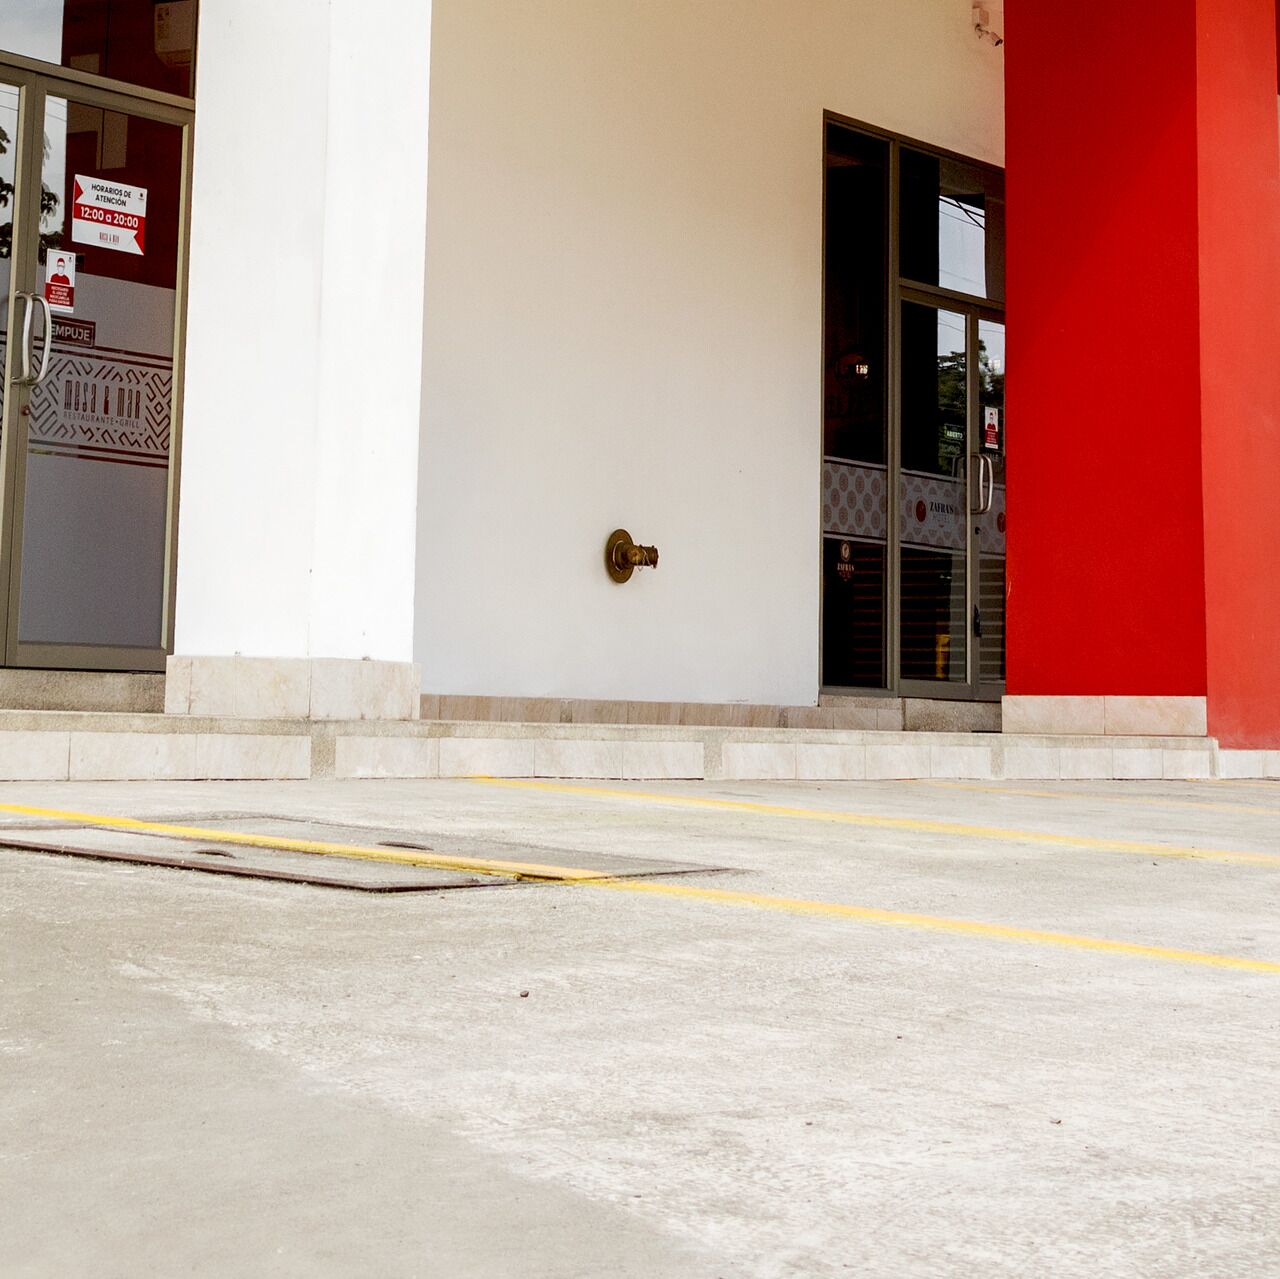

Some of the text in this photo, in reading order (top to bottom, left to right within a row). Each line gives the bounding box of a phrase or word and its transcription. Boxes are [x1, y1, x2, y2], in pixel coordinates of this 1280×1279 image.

[91, 184, 132, 198] HORARIOS DE
[95, 194, 127, 207] ATENCIÓN
[81, 206, 104, 221] 12:00
[113, 213, 139, 228] 20:00
[51, 323, 90, 340] EMPUJE
